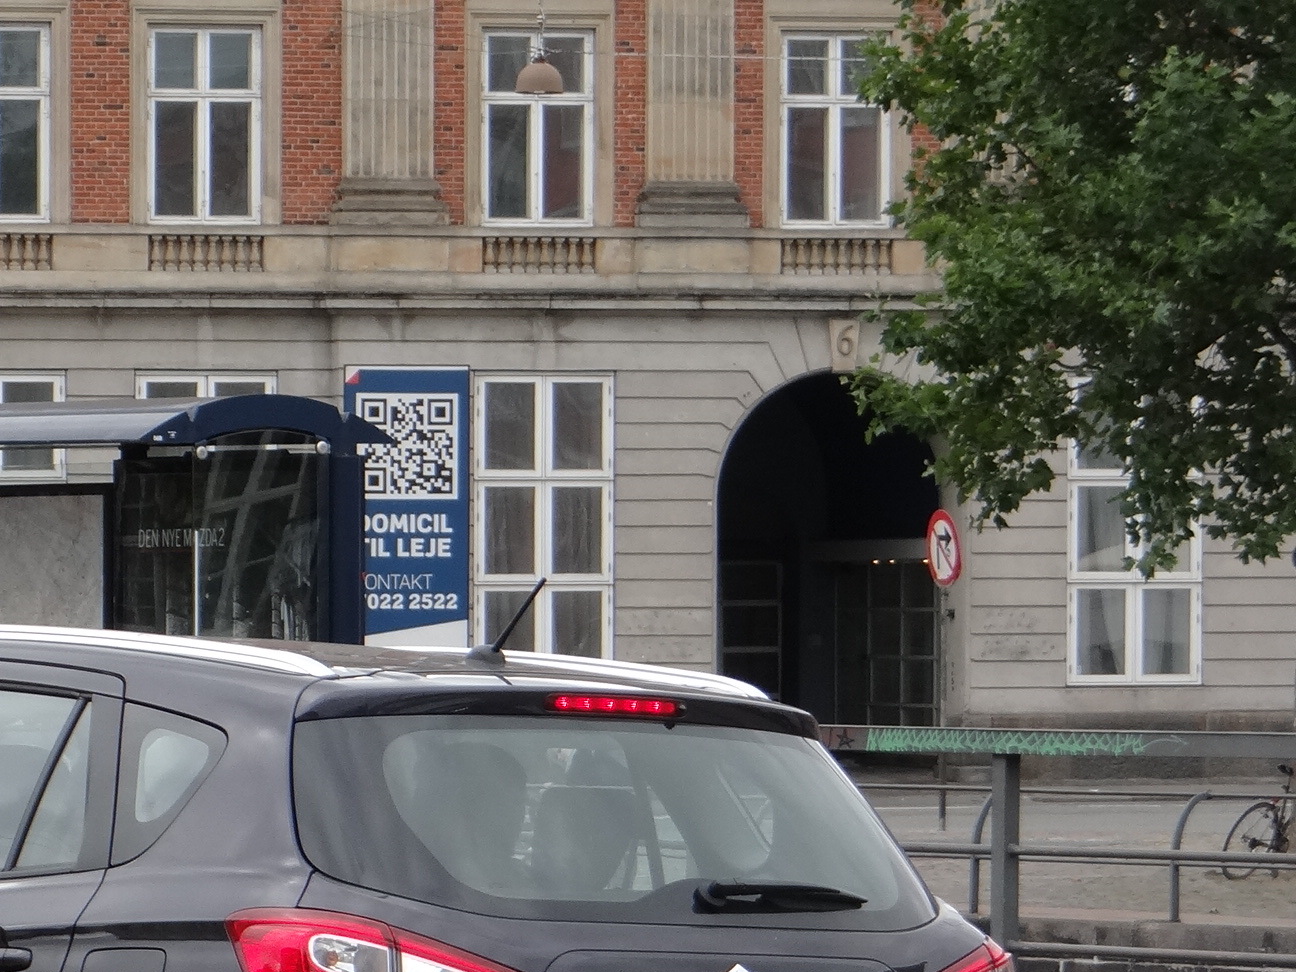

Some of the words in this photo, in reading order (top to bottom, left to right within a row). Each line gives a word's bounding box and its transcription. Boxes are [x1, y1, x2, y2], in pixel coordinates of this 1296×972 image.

[837, 324, 854, 356] 6
[138, 529, 159, 548] DEN
[162, 529, 181, 547] NYE
[183, 528, 225, 547] MZDA2
[396, 537, 452, 557] LEJE
[364, 573, 433, 590] ONTAKT
[364, 593, 404, 610] 022
[408, 593, 458, 610] 2522
